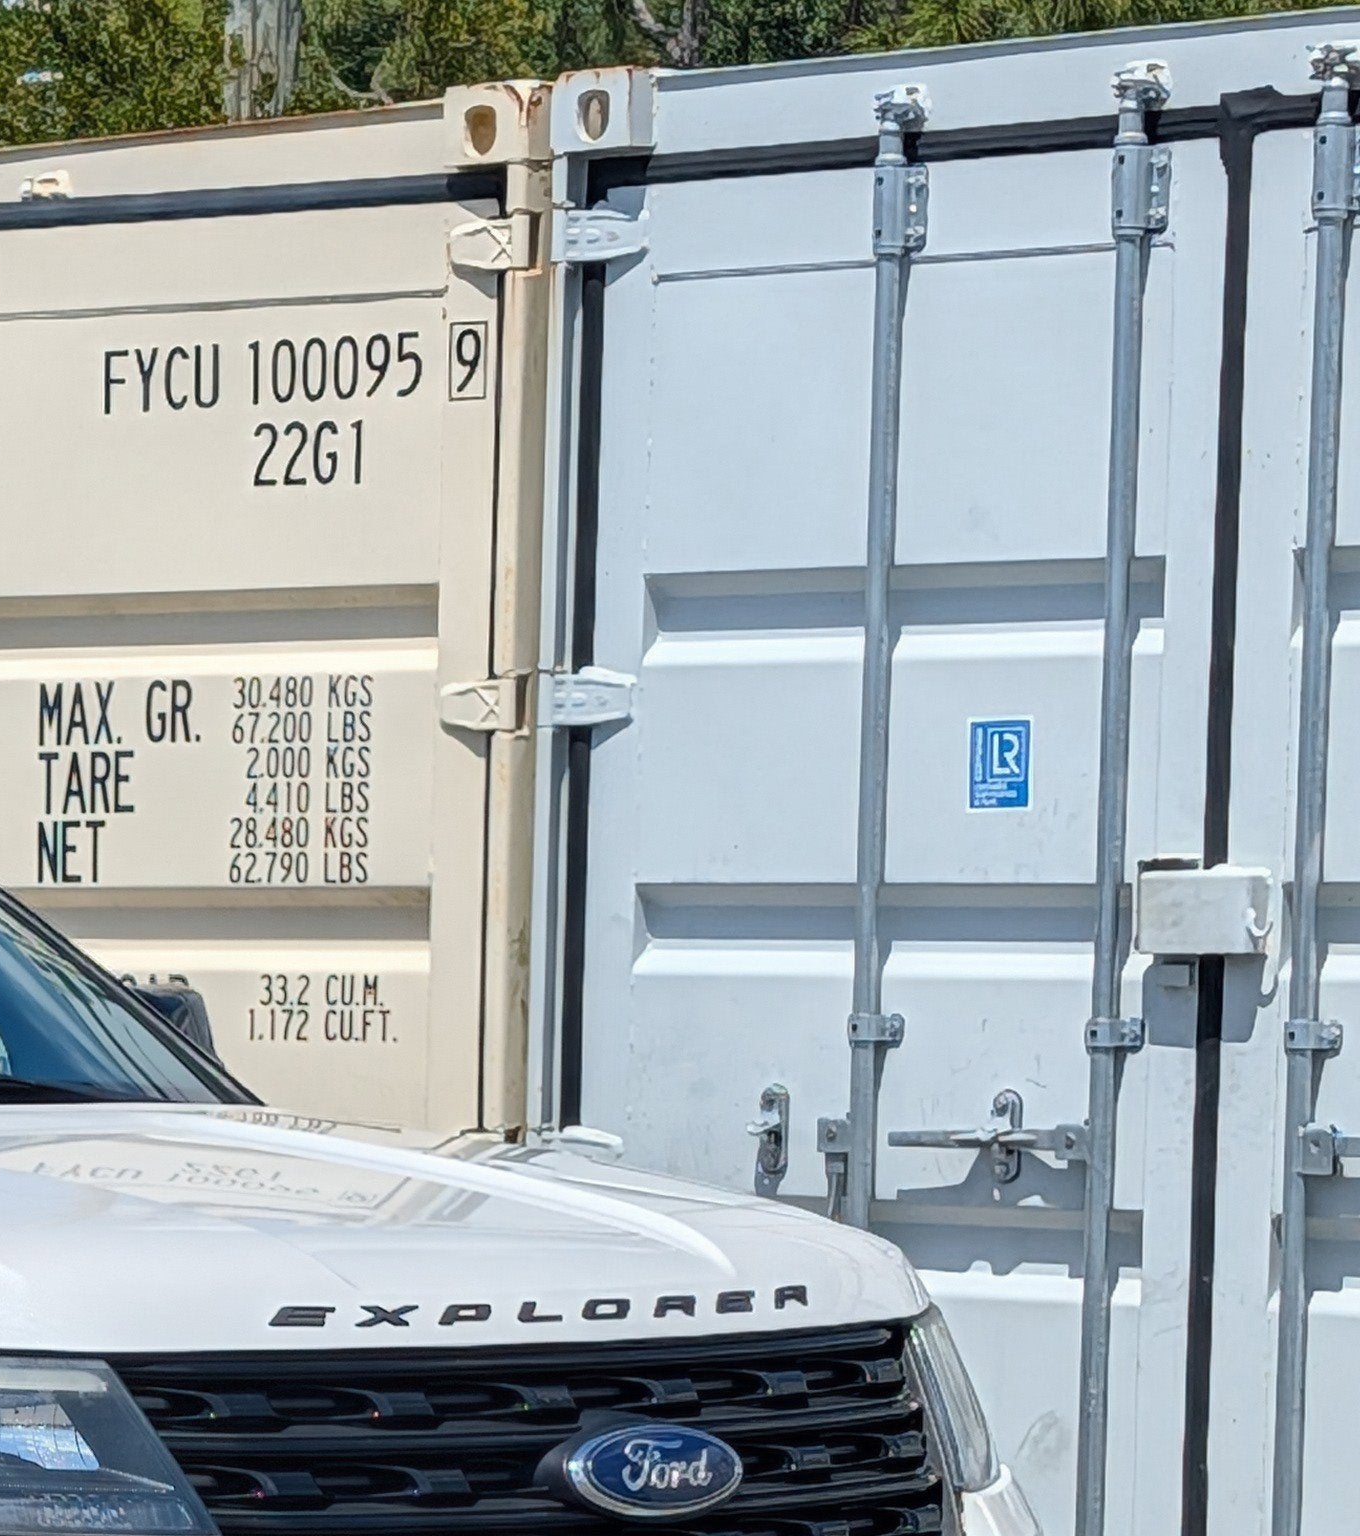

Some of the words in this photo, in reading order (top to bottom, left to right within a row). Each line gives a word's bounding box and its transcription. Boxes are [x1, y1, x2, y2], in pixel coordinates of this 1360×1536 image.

[102, 343, 221, 415] FYCU
[247, 330, 423, 406] 100095
[455, 328, 482, 394] 9
[253, 419, 364, 487] 22G1
[38, 681, 122, 747] MAX.
[145, 679, 201, 743] GR.
[232, 676, 314, 709] 30.480
[328, 675, 375, 708] KGS
[232, 711, 313, 744] 67.200
[326, 710, 372, 743] LBS
[37, 750, 136, 815] TARE
[245, 747, 311, 778] 2.000
[326, 746, 372, 778] KGS
[245, 782, 311, 814] 4.410
[324, 781, 370, 814] LBS
[37, 820, 106, 884] NET
[229, 817, 309, 849] 28.480
[323, 816, 369, 848] KGS
[229, 852, 309, 884] 62.790
[323, 852, 368, 883] LBS
[259, 974, 311, 1006] 33.2
[325, 974, 384, 1007] CU.M.
[248, 1009, 310, 1041] 1.172
[324, 1009, 398, 1042] CU.FT.
[267, 1284, 809, 1329] EXPLORER
[621, 1437, 714, 1491] Ford
